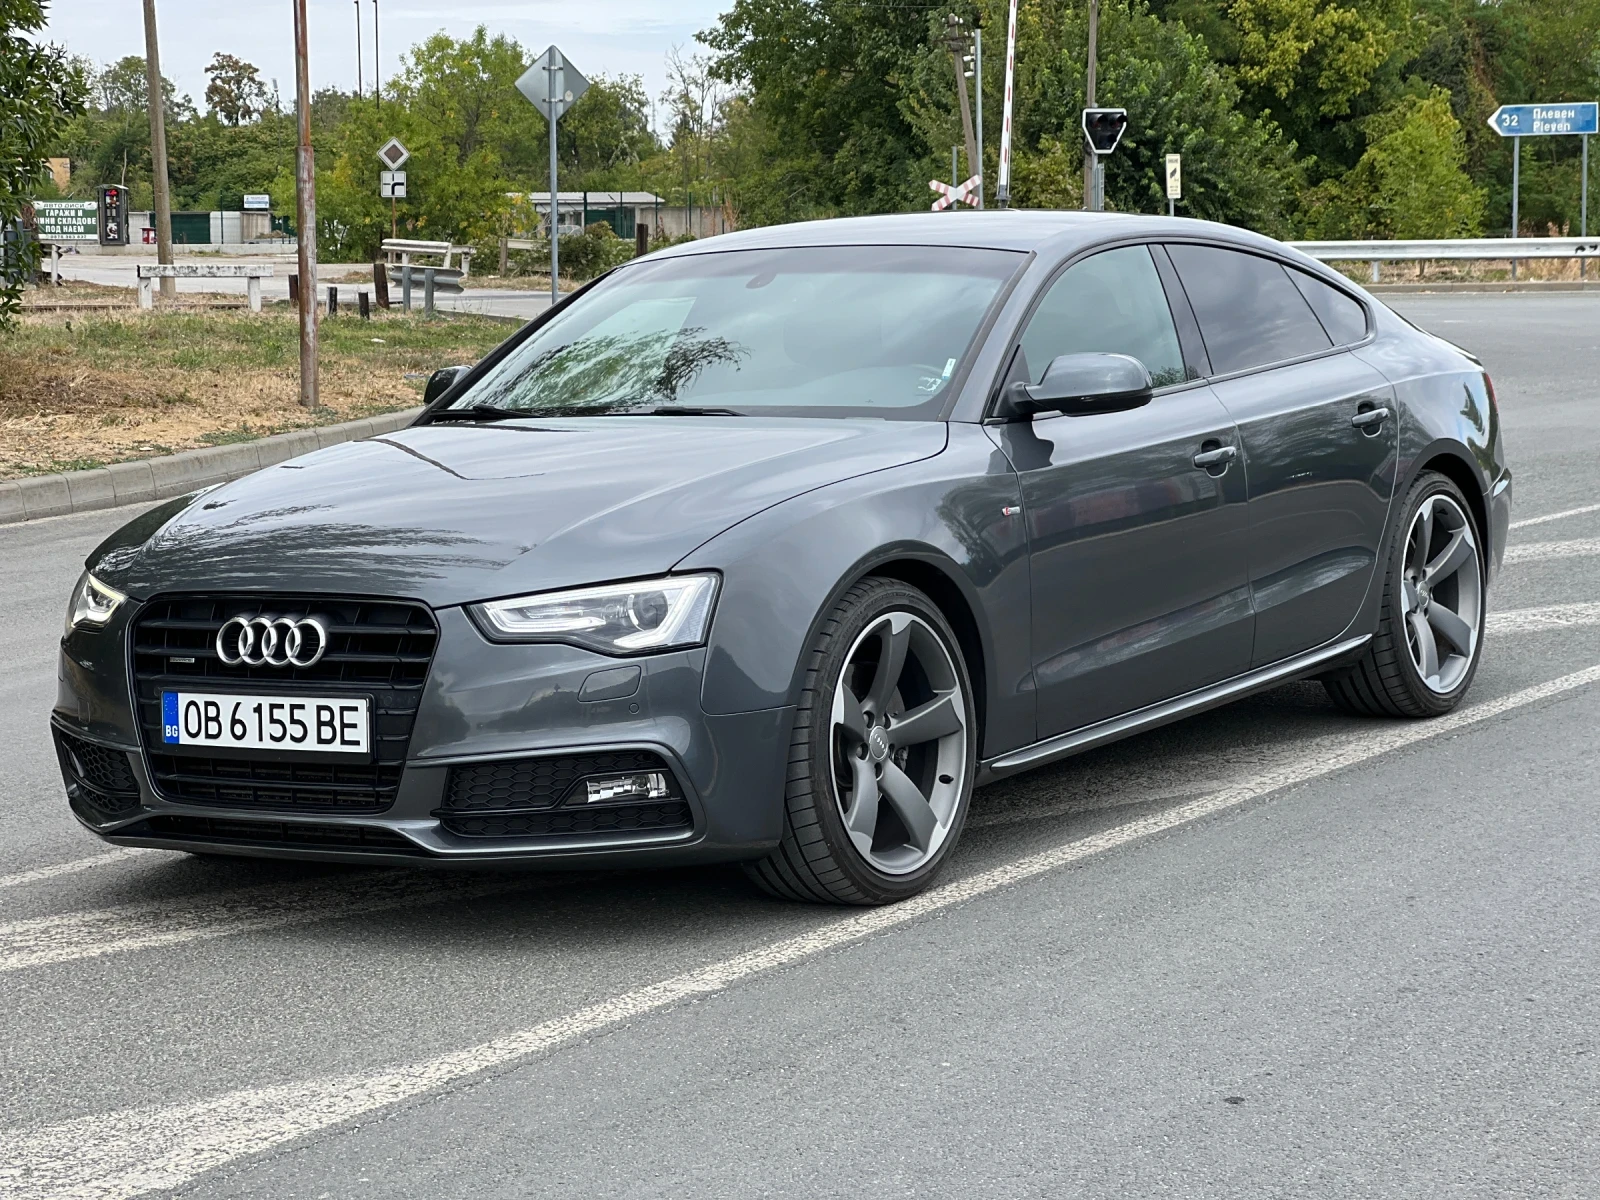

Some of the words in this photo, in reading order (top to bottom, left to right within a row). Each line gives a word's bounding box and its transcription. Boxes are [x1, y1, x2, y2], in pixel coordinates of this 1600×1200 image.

[1533, 108, 1575, 119] Плевен
[1501, 114, 1518, 126] 32
[1533, 121, 1571, 132] Pleven
[45, 209, 75, 217] ГАРАЖИ
[77, 209, 83, 217] И
[57, 217, 97, 225] СКЛАДОВЕ
[45, 225, 61, 234] ПОД
[63, 225, 84, 233] НАЕМ
[184, 700, 222, 739] OB
[230, 702, 308, 743] 6155
[316, 704, 361, 746] BE
[165, 725, 178, 737] BG
